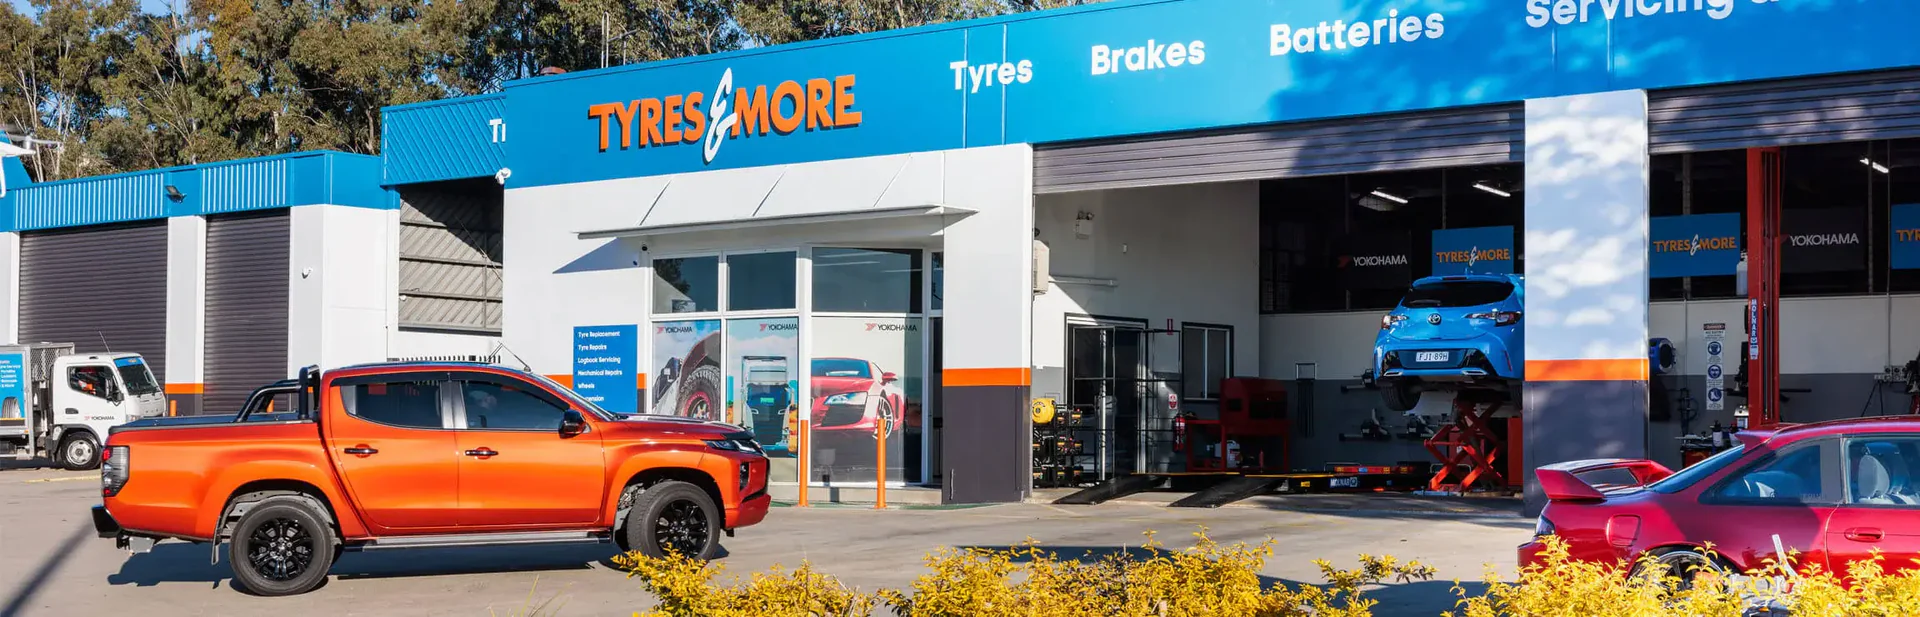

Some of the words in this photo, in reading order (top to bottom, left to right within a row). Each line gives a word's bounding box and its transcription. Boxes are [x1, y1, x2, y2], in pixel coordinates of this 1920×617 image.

[1269, 9, 1445, 57] Batteries
[1091, 38, 1206, 76] Brakes
[950, 56, 1033, 93] Tyres
[1789, 232, 1860, 247] YOKOHAMA
[1353, 254, 1408, 267] YOKOHAMA
[665, 326, 693, 334] YOKOHAMA
[768, 323, 798, 331] YOKOHAMA
[877, 323, 918, 332] YOKOHAMA
[578, 357, 598, 365] Logbook
[598, 356, 621, 364] Servicing
[605, 368, 623, 377] Repairs
